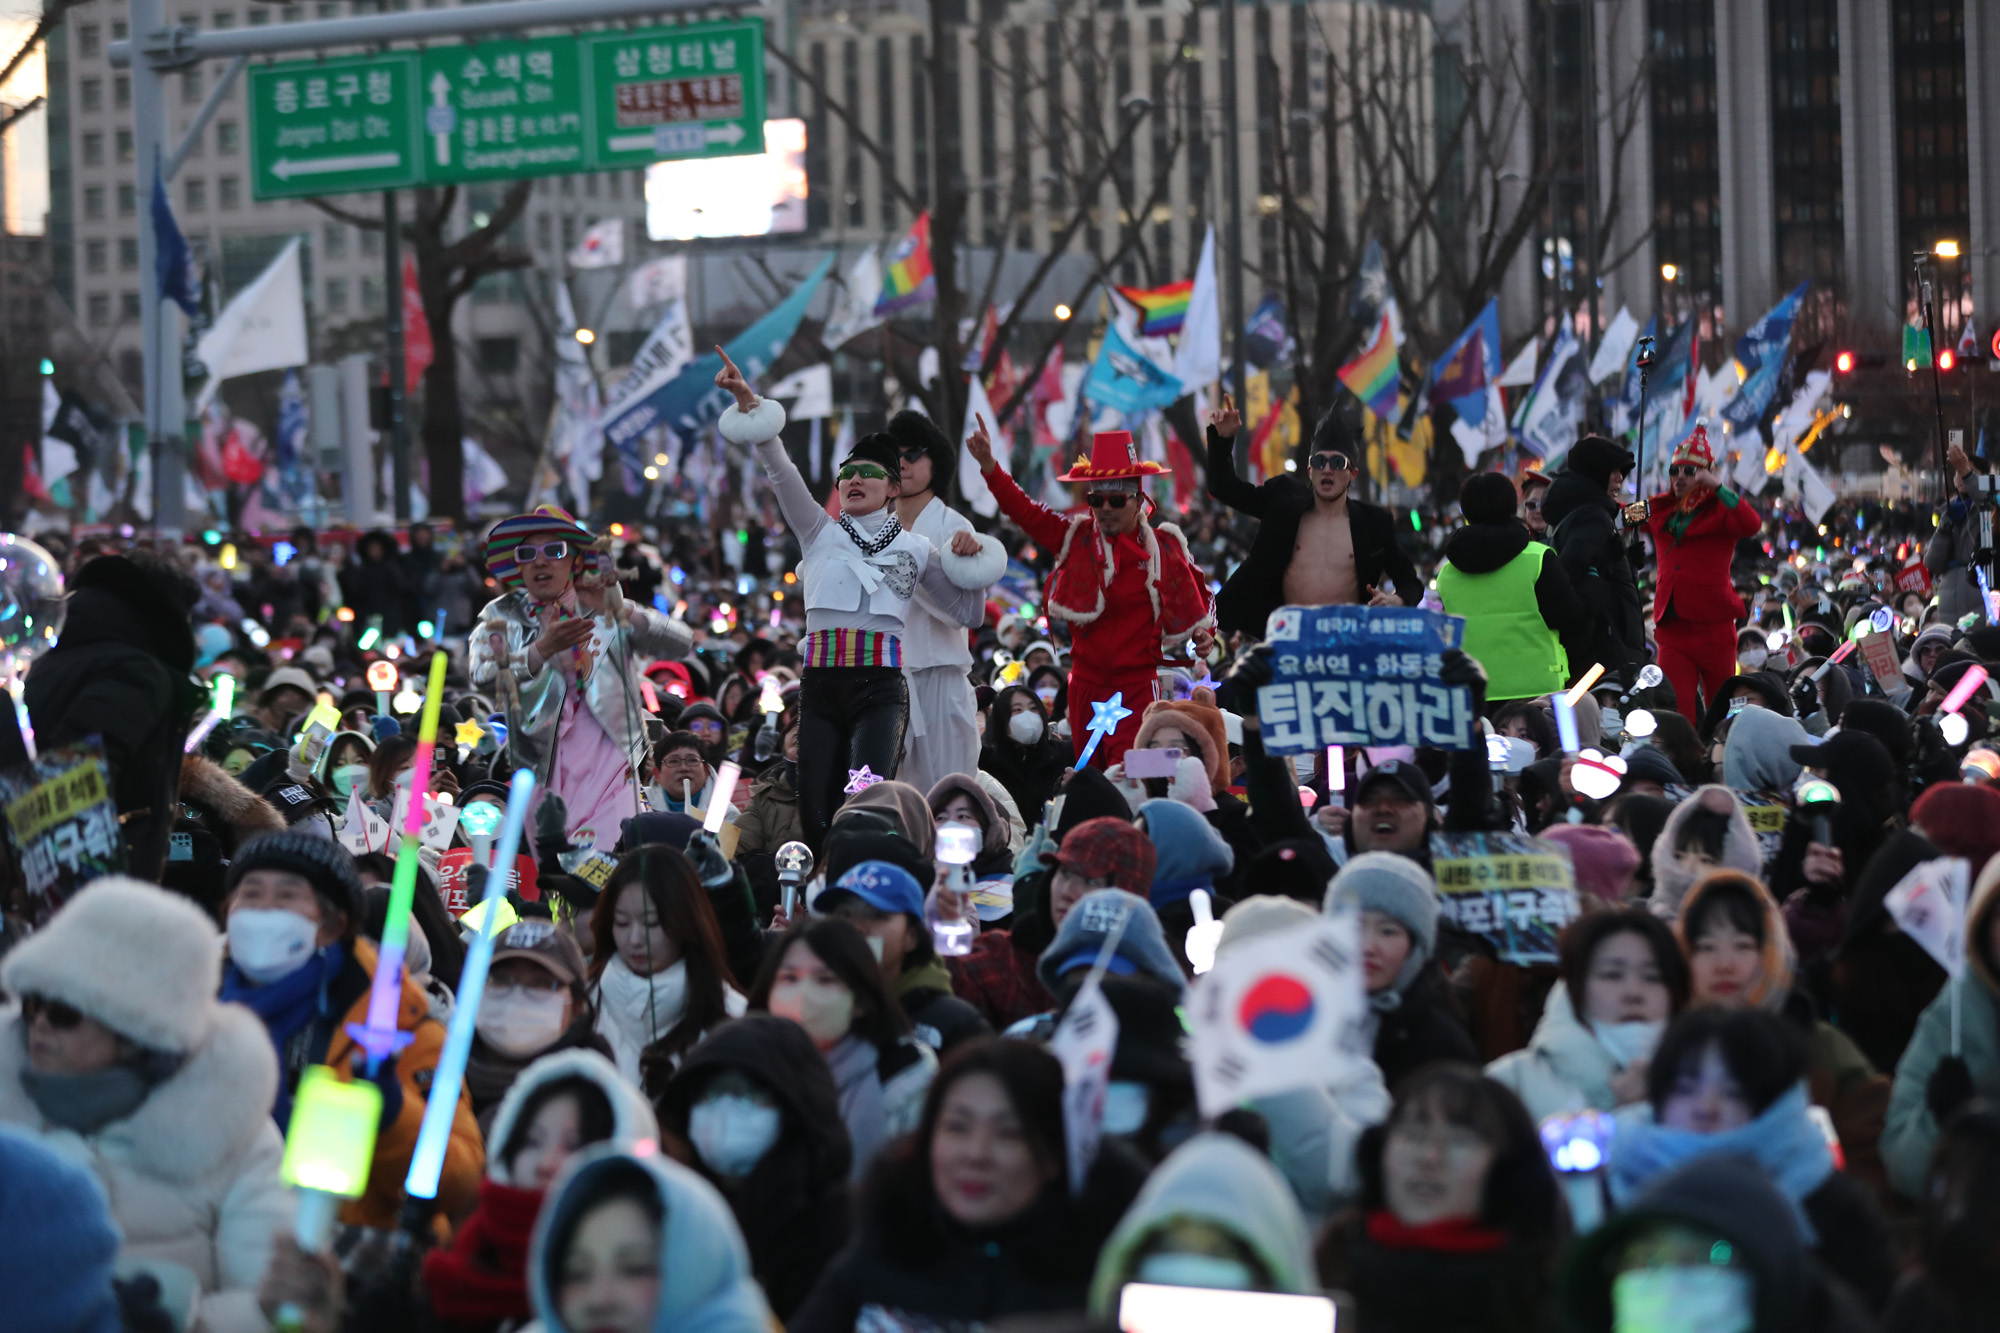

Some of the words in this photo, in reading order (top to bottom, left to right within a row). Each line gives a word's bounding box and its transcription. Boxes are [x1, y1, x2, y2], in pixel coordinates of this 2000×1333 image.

[461, 51, 553, 86] 수색역
[615, 39, 736, 77] 삼청터널
[275, 70, 391, 114] 종로구청
[1257, 680, 1473, 750] 퇴진하라
